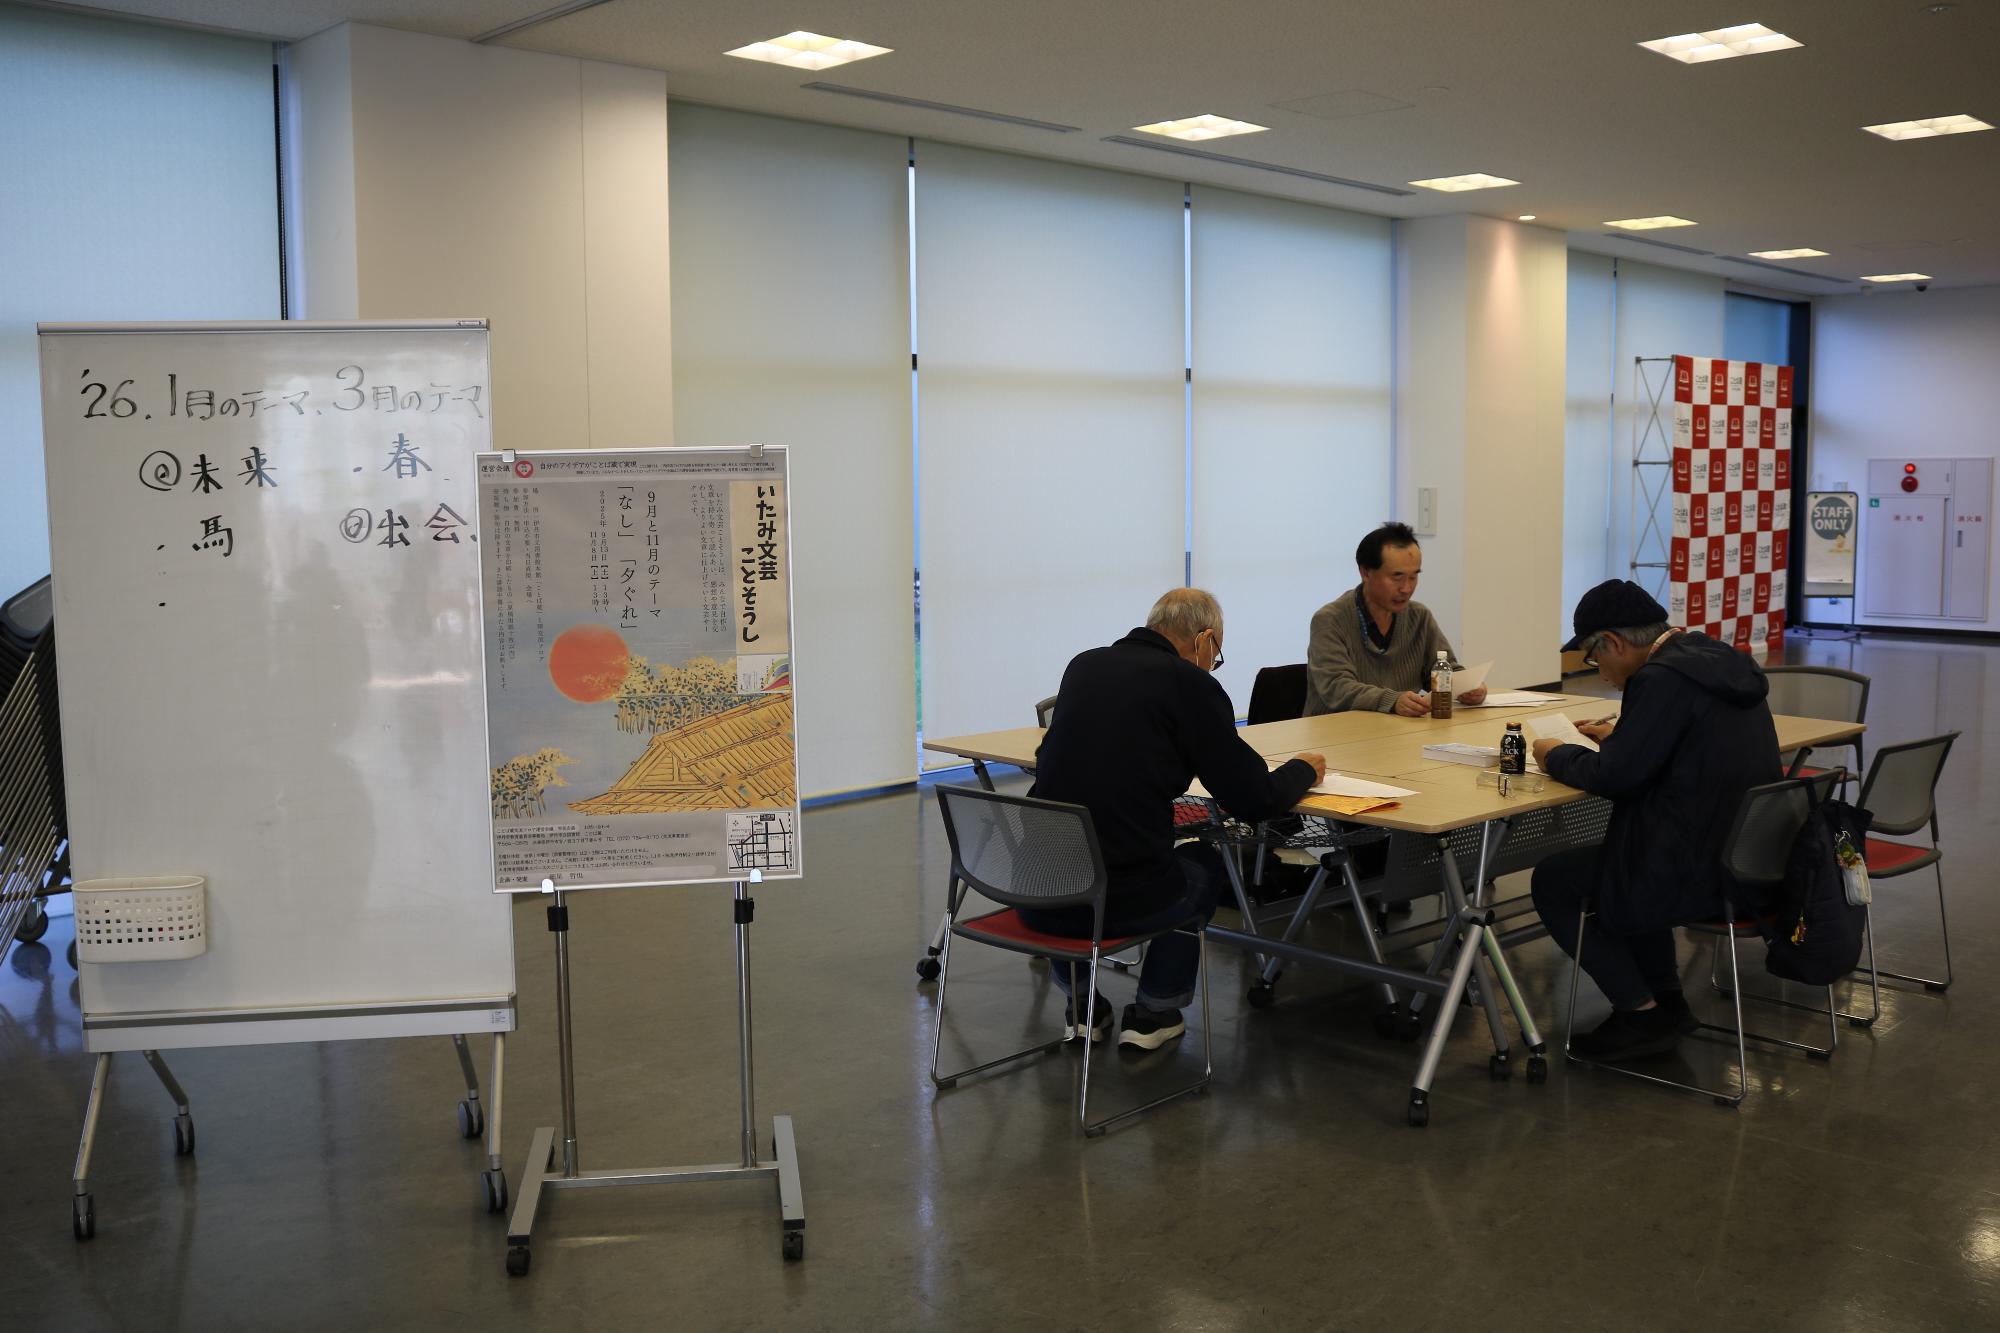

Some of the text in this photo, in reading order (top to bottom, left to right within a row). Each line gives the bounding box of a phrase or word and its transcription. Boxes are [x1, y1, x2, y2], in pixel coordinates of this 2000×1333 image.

[190, 446, 278, 494] 未来
[381, 432, 433, 480] 春
[192, 514, 235, 558] 馬
[756, 485, 778, 581] いたみ文芸
[1814, 506, 1851, 518] STAFF
[1814, 518, 1848, 531] ONLY
[617, 486, 638, 629] 「なし」 「夕ぐれ」
[647, 491, 661, 618] 9月と11月のテーマ
[741, 547, 760, 643] ことそうし
